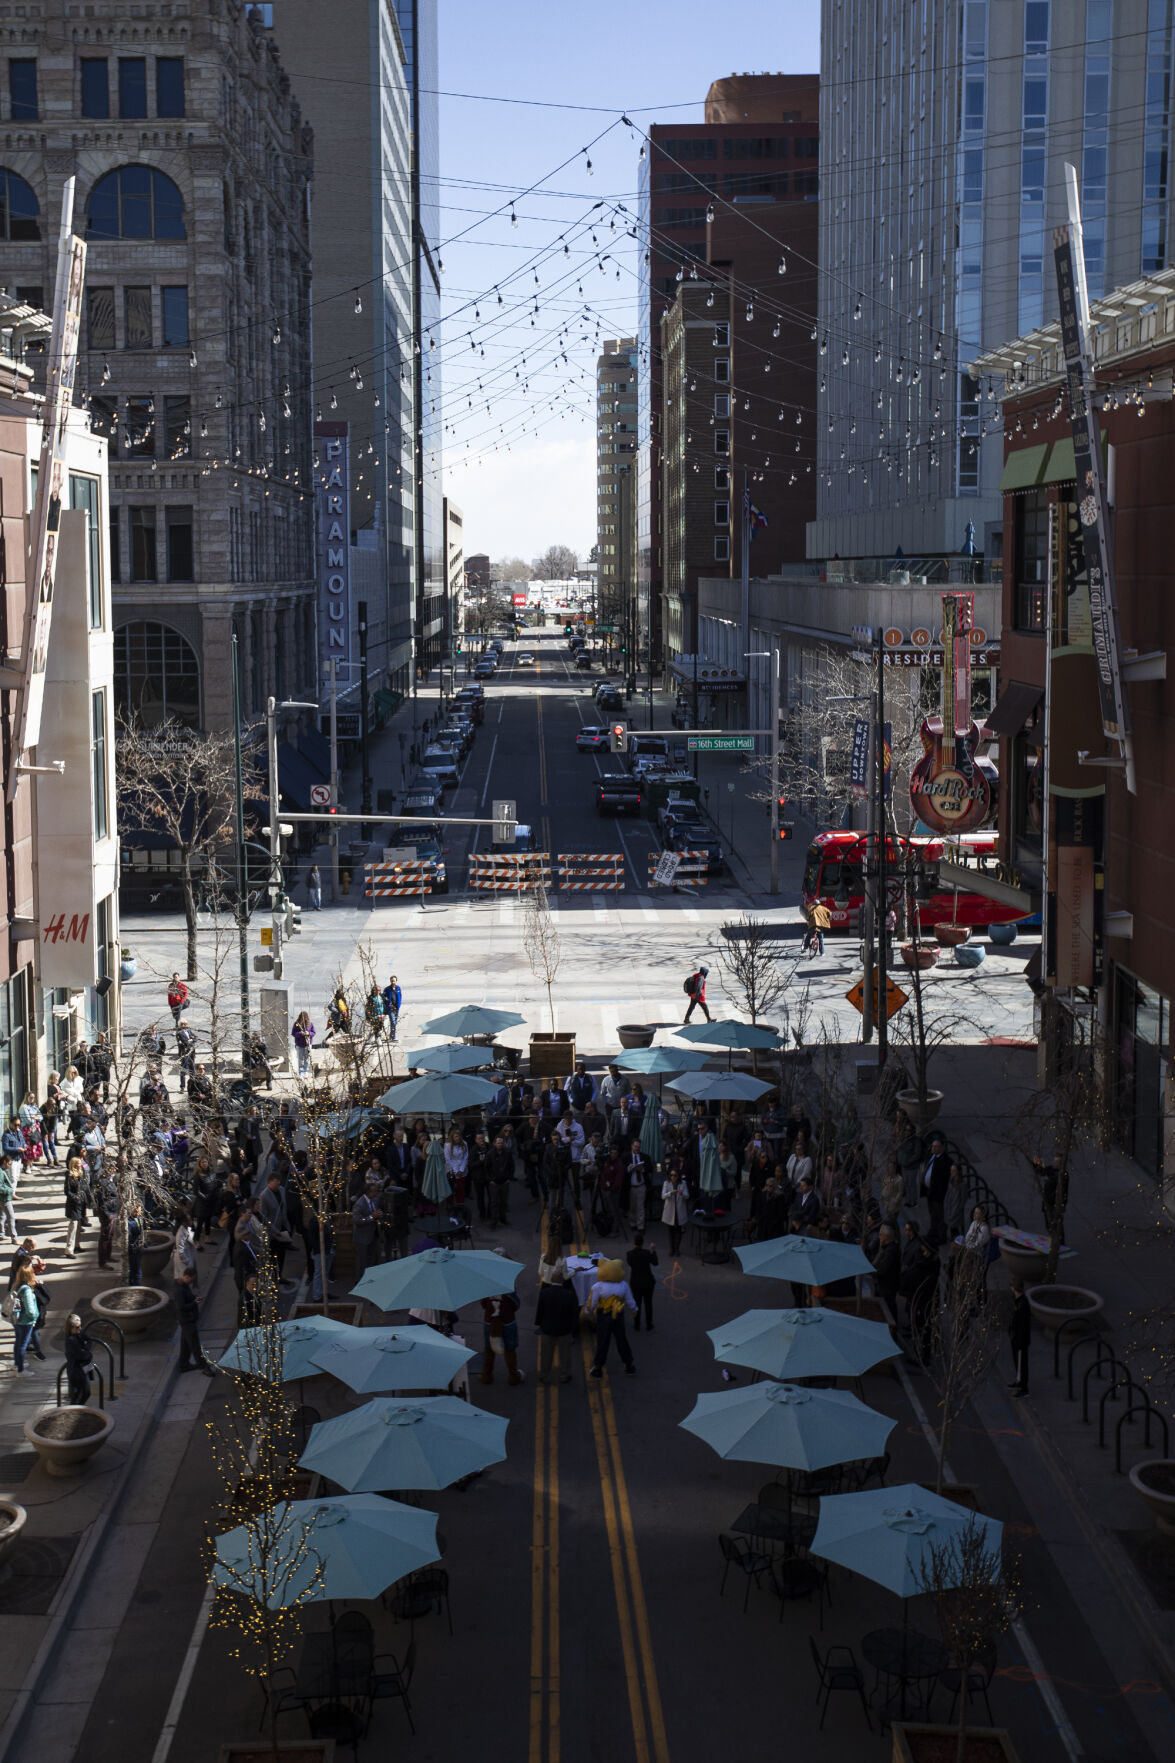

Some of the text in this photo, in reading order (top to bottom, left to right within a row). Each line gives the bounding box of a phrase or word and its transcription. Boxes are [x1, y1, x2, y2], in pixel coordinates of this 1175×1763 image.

[326, 442, 345, 673] PARAMOUNT
[1090, 567, 1112, 685] GRIMALDI'S
[883, 654, 987, 664] RESIDEES
[697, 738, 752, 749] 16th Street Mall
[852, 723, 864, 780] UPPER
[859, 725, 868, 781] DOWNTOWN
[911, 776, 986, 804] Hard Rock
[1072, 885, 1082, 911] USED
[43, 913, 90, 945] H&M
[1071, 932, 1081, 949] THE
[1071, 951, 1081, 984] WHERE
